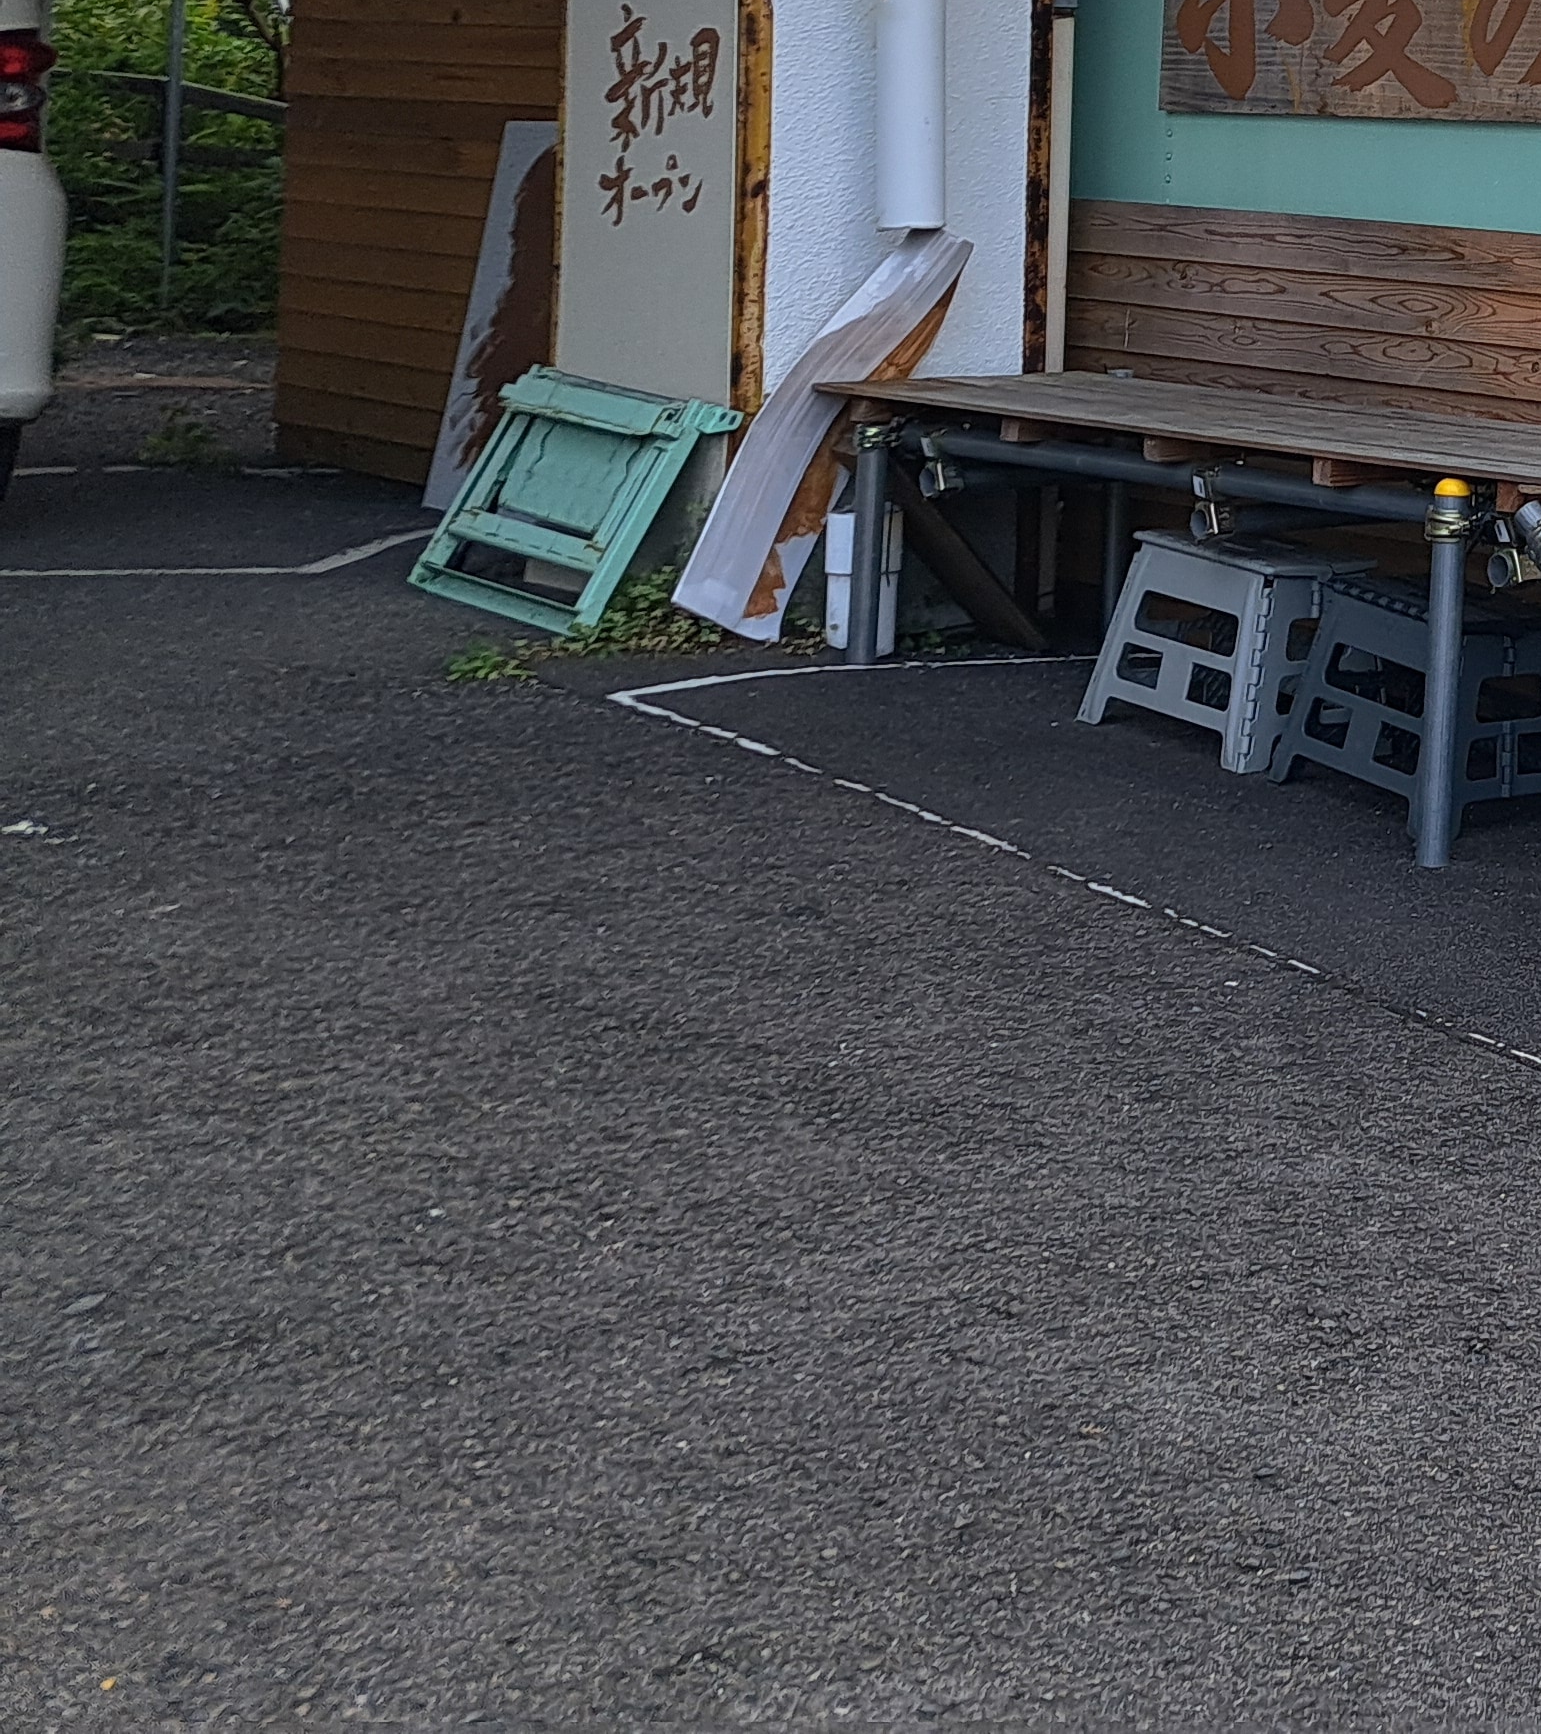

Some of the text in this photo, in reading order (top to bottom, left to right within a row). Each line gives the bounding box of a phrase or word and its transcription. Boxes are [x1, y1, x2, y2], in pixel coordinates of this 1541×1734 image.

[606, 5, 721, 151] 新規
[600, 154, 705, 226] オープン
